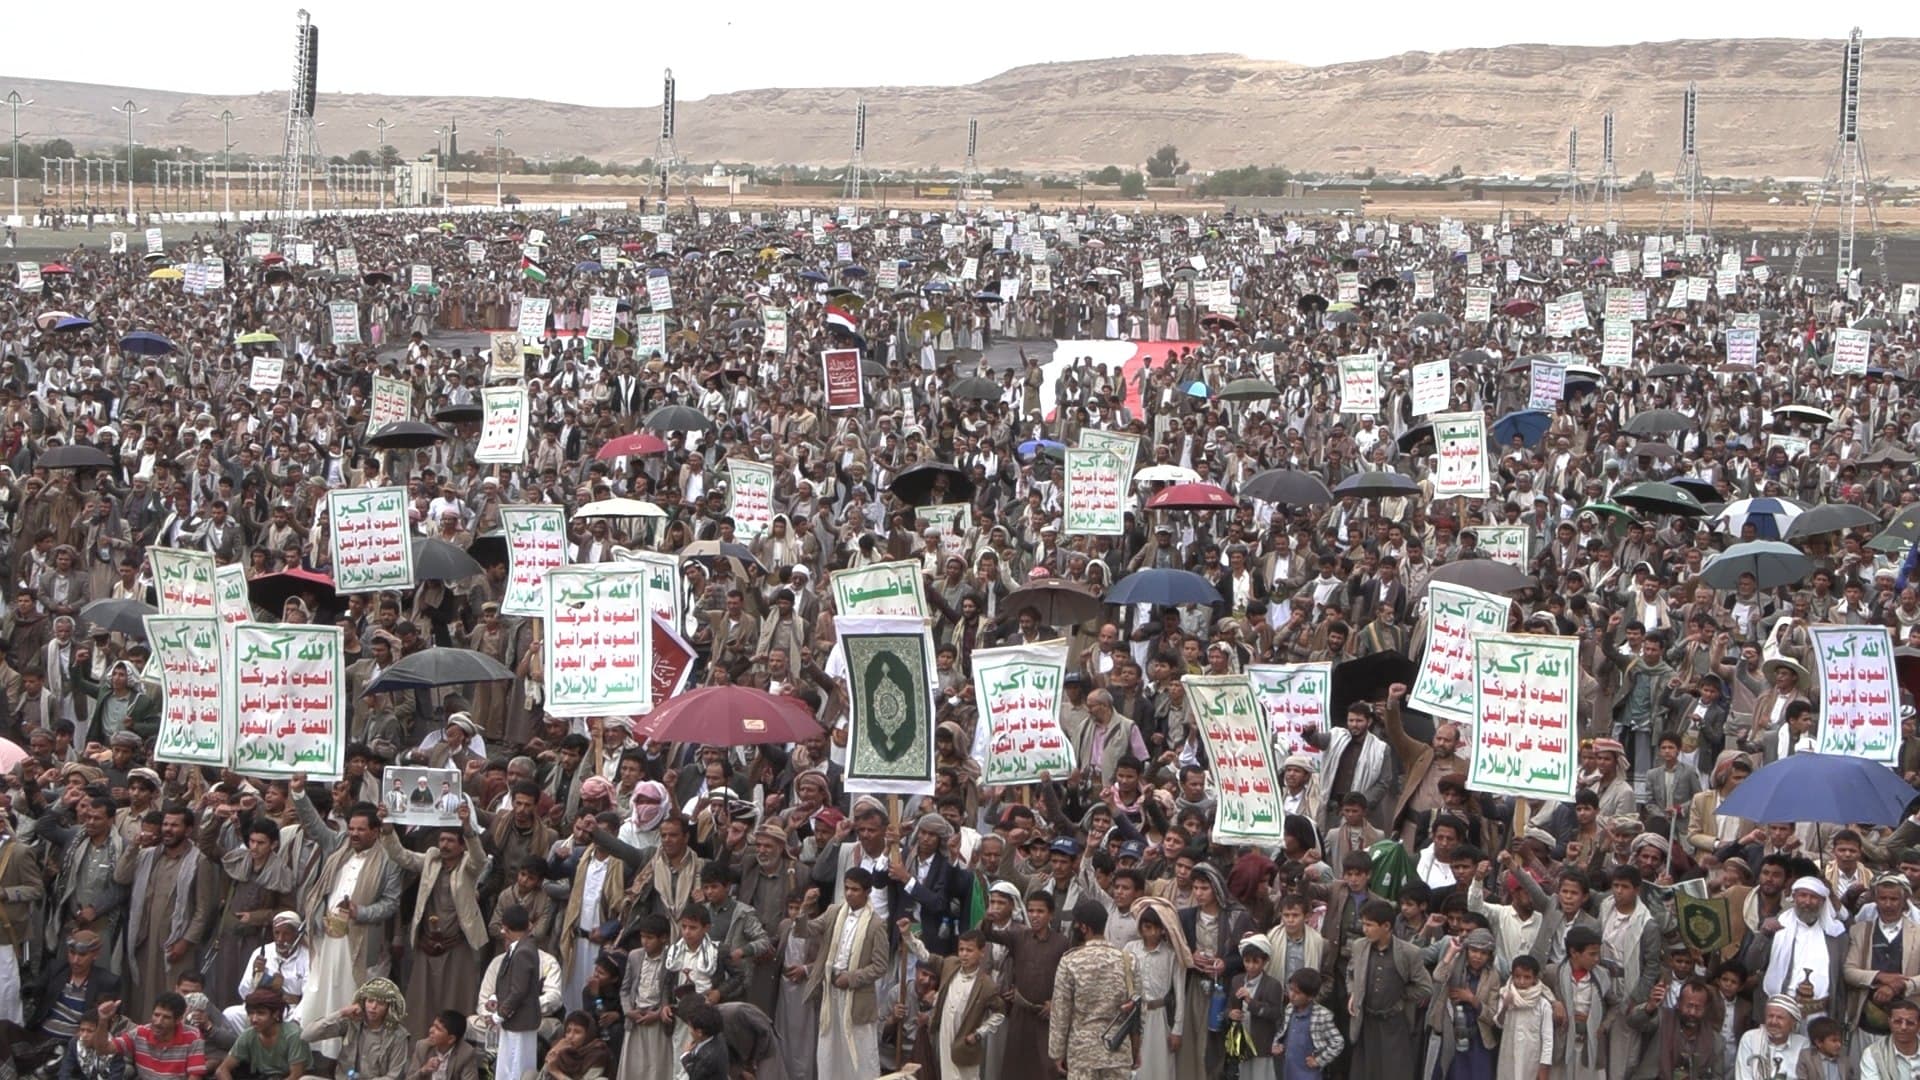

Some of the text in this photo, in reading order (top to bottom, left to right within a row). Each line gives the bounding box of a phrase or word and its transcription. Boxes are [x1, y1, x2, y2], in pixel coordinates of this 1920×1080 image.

[337, 495, 400, 518] الله أكبر
[375, 517, 401, 530] الموت
[542, 516, 559, 531] الله
[376, 534, 402, 547] الموت
[538, 540, 562, 551] الموت
[341, 551, 404, 567] اللعنة على اليهود
[539, 557, 563, 568] الموت
[378, 565, 405, 582] النصر
[555, 576, 606, 604] أكبر
[609, 577, 639, 598] الله
[844, 576, 913, 607] قاطعوا
[603, 608, 639, 625] الموت
[1476, 604, 1502, 625] الله
[241, 633, 332, 664] الله أكبر
[603, 632, 639, 648] الموت
[1826, 633, 1885, 663] الله أكبر
[555, 654, 639, 671] اللعنة على اليهود
[1428, 661, 1464, 680] على اليهود
[1483, 649, 1568, 677] الله أكبر
[292, 670, 332, 687] الموت
[989, 667, 1053, 698] الله أكبر
[1858, 666, 1888, 683] الموت
[602, 673, 639, 697] النصر
[1256, 675, 1322, 699] الله أكبر
[293, 696, 332, 713] الموت
[1233, 693, 1251, 715] الله
[1531, 689, 1567, 704] الموت
[1859, 690, 1890, 706] الموت
[1293, 703, 1322, 715] الموت
[240, 719, 332, 737] اللعنة على اليهود
[1529, 713, 1567, 729] الموت
[1829, 712, 1891, 729] اللعنة على اليهود
[1040, 736, 1064, 749] اللعنة
[1235, 725, 1258, 744] الموت
[1482, 732, 1567, 754] اللعنة على اليهود
[1860, 732, 1891, 754] النصر
[289, 740, 331, 766] النصر
[1019, 737, 1035, 752] على
[1034, 753, 1066, 773] النصر
[1241, 751, 1265, 770] الموت
[1525, 759, 1566, 783] النصر
[1250, 798, 1277, 828] النصر
